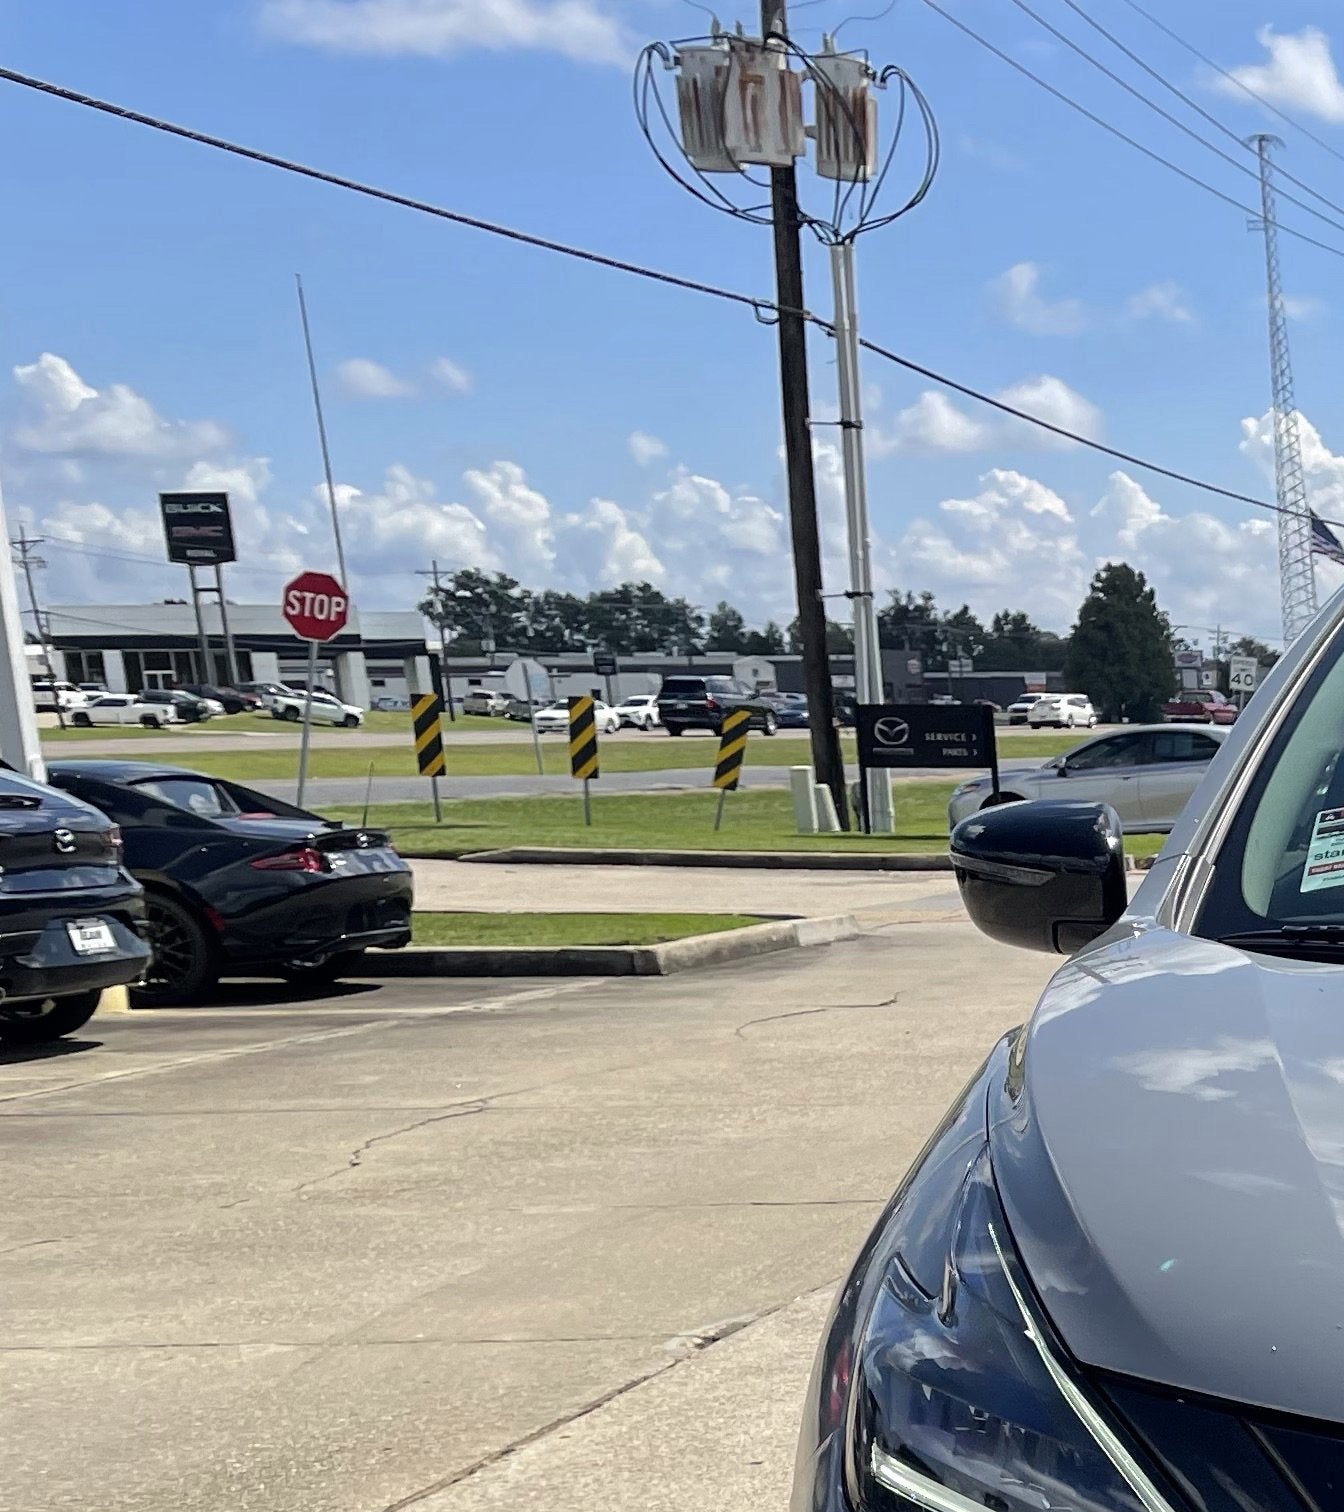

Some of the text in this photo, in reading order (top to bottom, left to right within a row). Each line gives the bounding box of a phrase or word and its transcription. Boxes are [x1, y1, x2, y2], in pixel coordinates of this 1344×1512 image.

[165, 503, 224, 513] BUICK
[286, 589, 345, 621] STOP
[1231, 673, 1253, 686] 40
[924, 732, 967, 742] SERVICE
